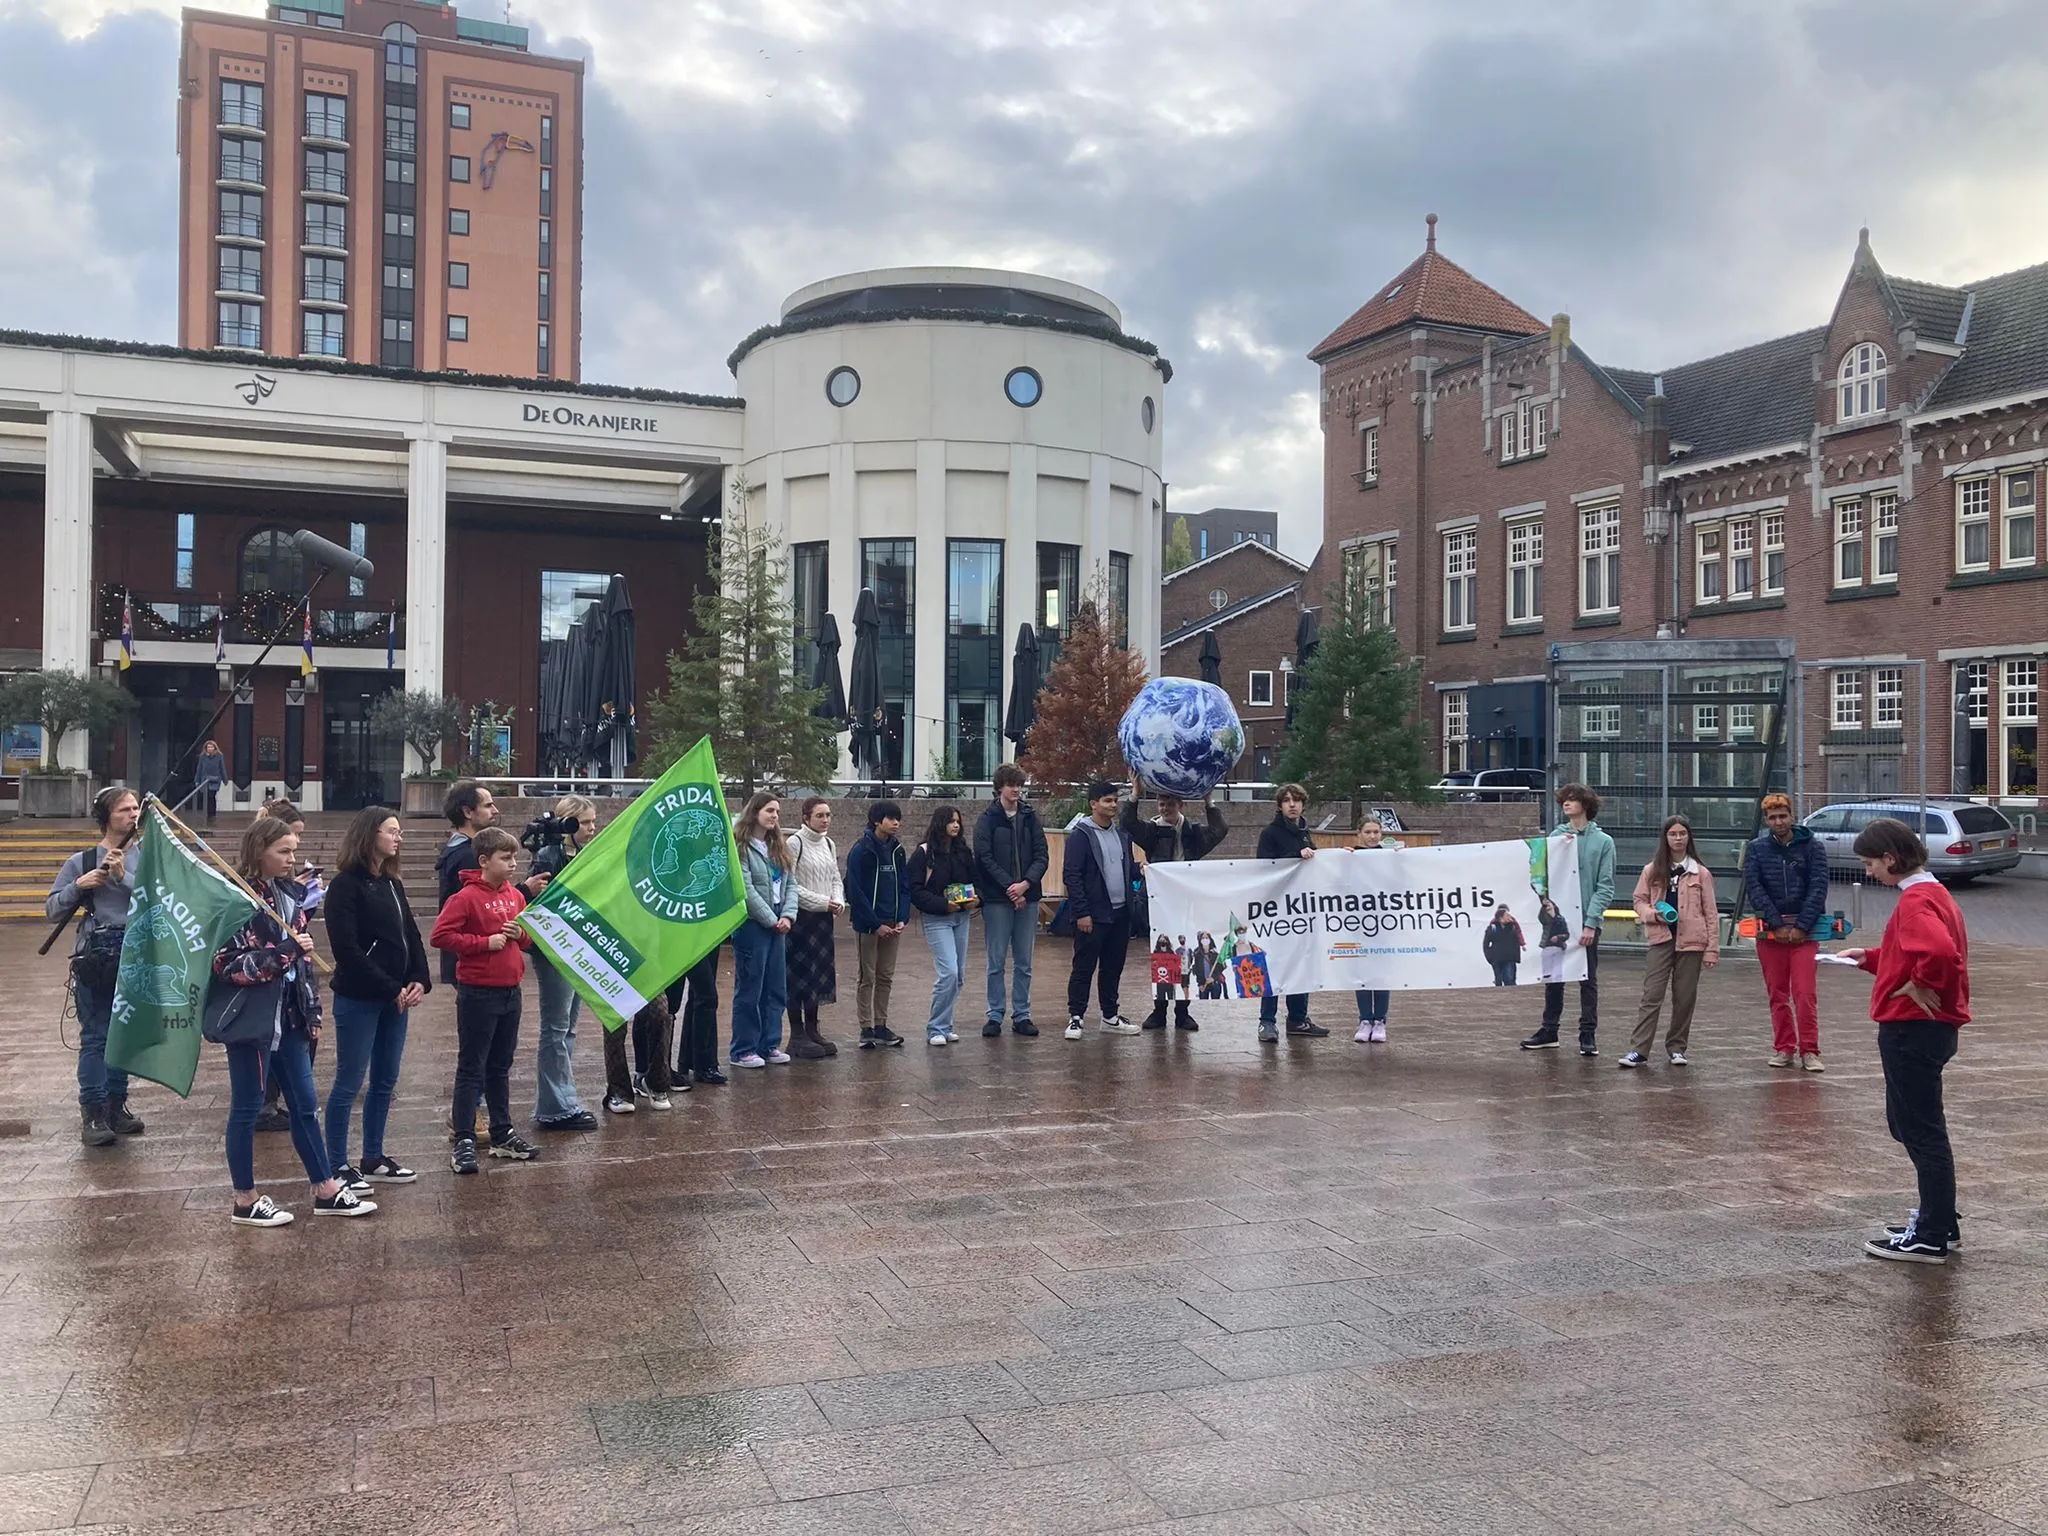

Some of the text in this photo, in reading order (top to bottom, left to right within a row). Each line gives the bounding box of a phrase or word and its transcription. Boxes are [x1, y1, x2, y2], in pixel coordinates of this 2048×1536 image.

[654, 787, 718, 818] FRIDA
[635, 877, 707, 919] FUTURE
[1248, 886, 1495, 920] De klimaatstrijd is
[558, 896, 630, 973] Wir streiken,
[1252, 910, 1471, 938] weer begonnen
[552, 929, 573, 950] Ihr
[571, 947, 624, 998] handelt!
[1327, 948, 1354, 956] FRIDAYS
[1397, 946, 1437, 954] NEDERLAND
